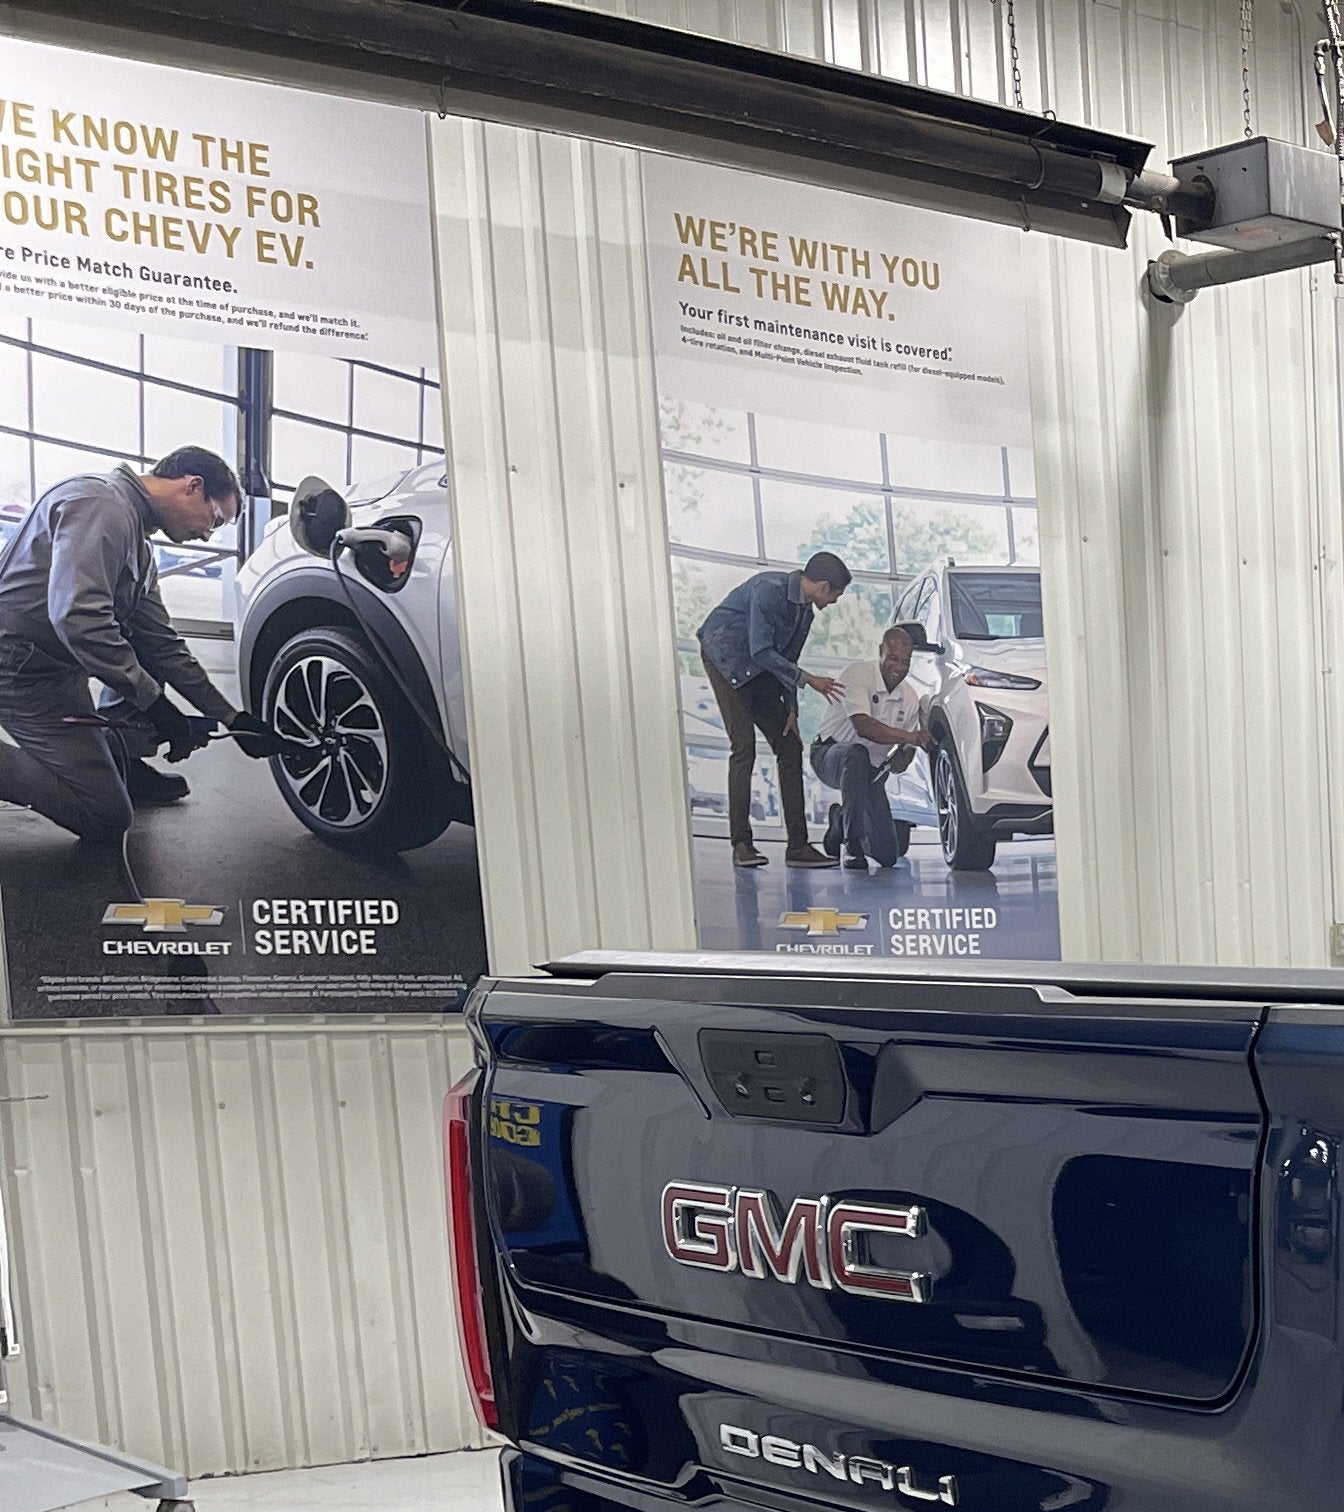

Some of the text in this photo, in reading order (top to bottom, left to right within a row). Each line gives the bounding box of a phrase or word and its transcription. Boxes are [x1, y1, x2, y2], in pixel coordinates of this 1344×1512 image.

[0, 99, 271, 177] E KNOW THE
[113, 164, 232, 215] TIRES
[246, 185, 321, 228] FOR
[105, 207, 241, 259] CHEVY
[256, 230, 315, 270] EV.
[674, 212, 941, 290] WE'RE WITH YOU
[21, 246, 70, 269] Price
[76, 256, 133, 279] Match
[139, 265, 238, 294] Guarantee.
[677, 254, 896, 321] ALL THE WAY.
[13, 285, 45, 297] better
[48, 292, 73, 302] price
[75, 295, 107, 307] within
[109, 300, 121, 309] 30
[124, 301, 146, 313] days
[149, 305, 158, 313] of
[160, 307, 176, 317] the
[227, 316, 244, 326] and
[269, 321, 299, 332] refund
[302, 326, 317, 335] the
[20, 274, 32, 283] us
[35, 275, 57, 287] with
[68, 280, 99, 293] better
[102, 286, 136, 299] eligible
[139, 293, 163, 303] price
[179, 296, 193, 306] the
[196, 299, 217, 309] time
[219, 302, 229, 312] of
[278, 311, 295, 320] and
[320, 316, 348, 326] match
[679, 301, 713, 321] Your
[717, 309, 750, 328] first
[754, 319, 844, 345] maintenance
[848, 334, 877, 350] visit
[880, 337, 892, 352] is
[252, 899, 400, 926] CERTIFIED
[888, 907, 998, 930] CERTIFIED
[102, 940, 232, 956] CHEVROLET
[254, 929, 378, 955] SERVICE
[775, 943, 875, 956] CHEVROLET
[890, 933, 982, 956] SERVICE
[661, 1179, 933, 1302] GMC
[719, 1423, 960, 1506] DENALI
